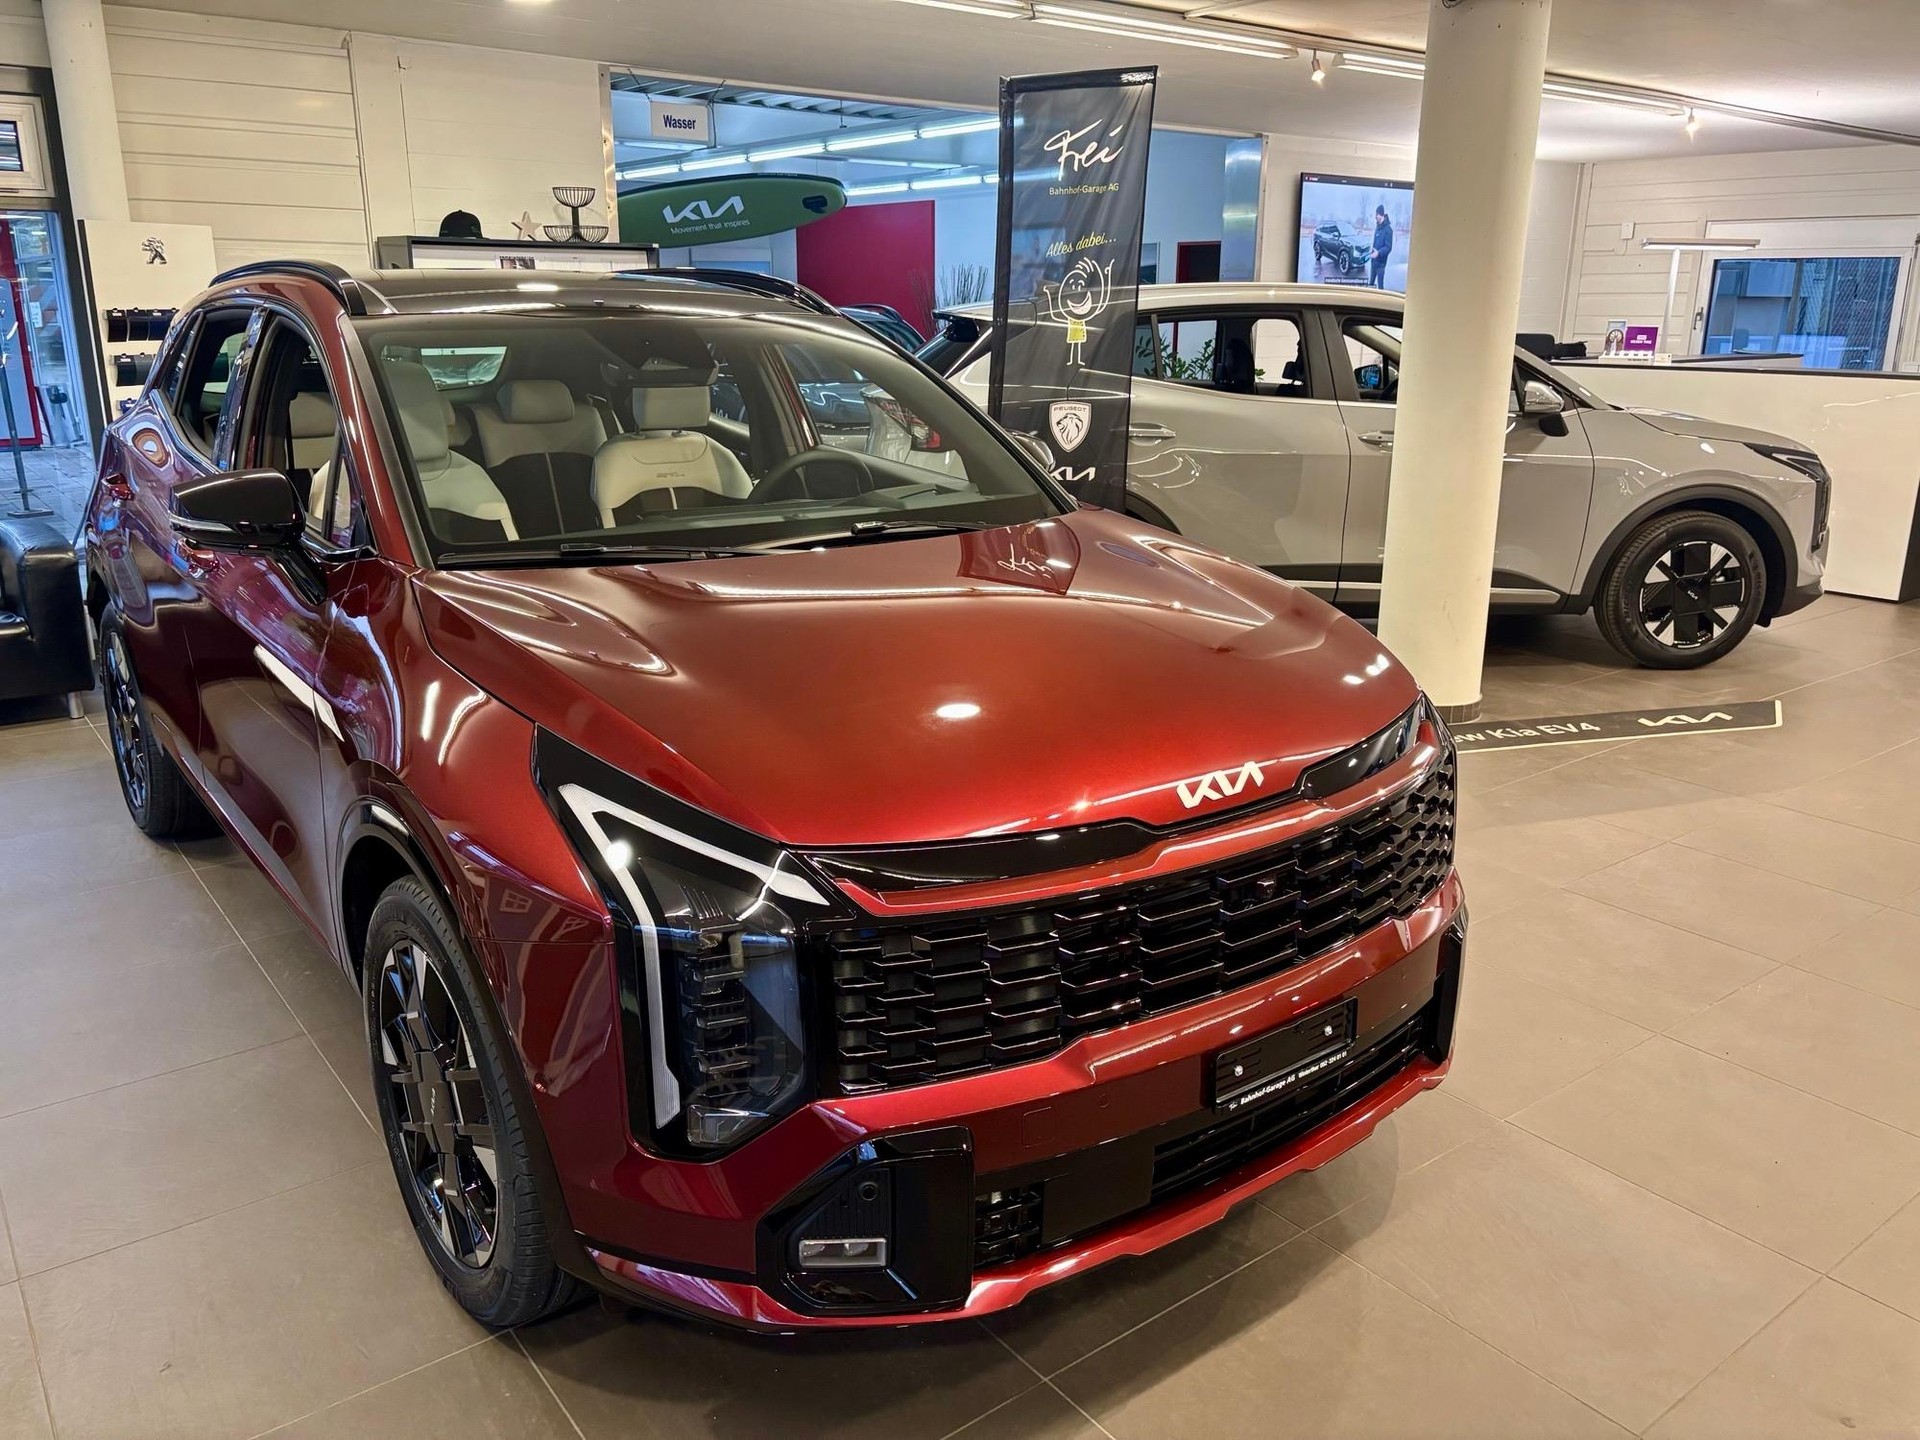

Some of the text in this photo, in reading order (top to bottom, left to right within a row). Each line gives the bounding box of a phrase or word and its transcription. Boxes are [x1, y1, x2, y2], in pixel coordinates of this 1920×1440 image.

[663, 115, 696, 130] Wasser
[1044, 119, 1124, 181] Frei
[1049, 183, 1120, 195] Bahnhof-Garage AG
[662, 195, 745, 224] KIA
[670, 219, 750, 235] Movement that inspires
[1046, 241, 1073, 257] Alles
[1637, 712, 1733, 727] KIA
[1485, 727, 1540, 739] Kia
[1536, 722, 1601, 735] EV4
[1176, 761, 1264, 809] KIA
[1240, 1080, 1286, 1105] Bahnhof-Garage
[1286, 1074, 1296, 1084] AG
